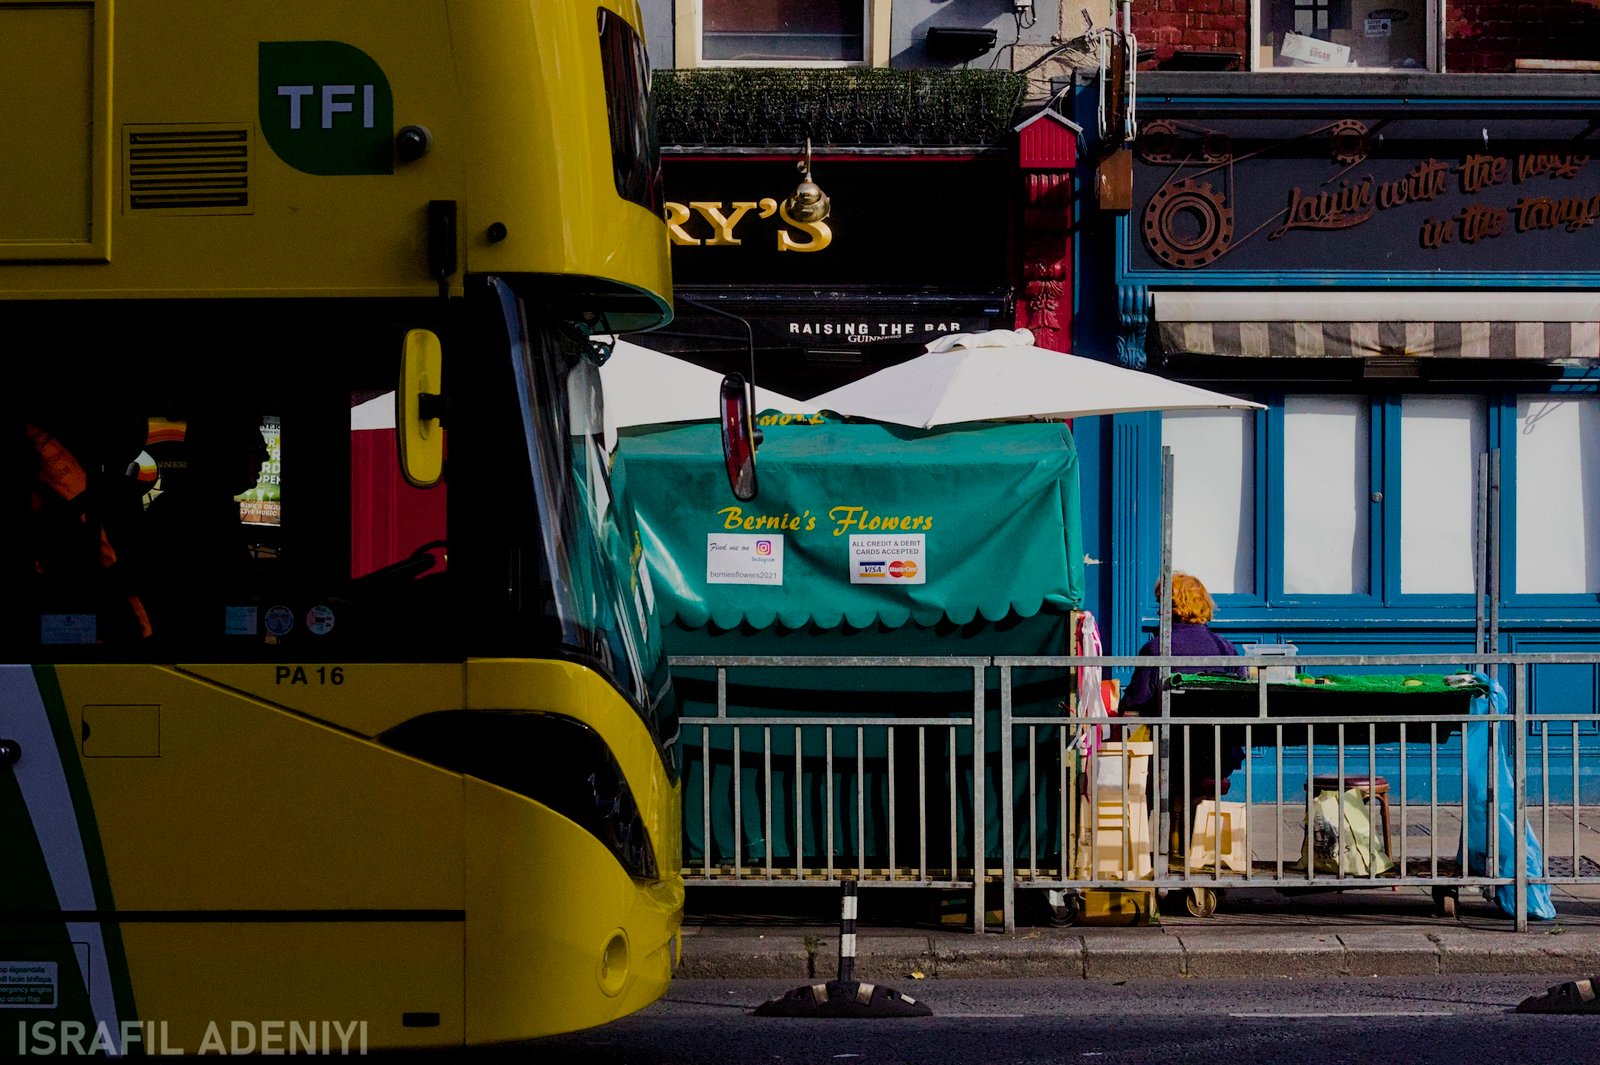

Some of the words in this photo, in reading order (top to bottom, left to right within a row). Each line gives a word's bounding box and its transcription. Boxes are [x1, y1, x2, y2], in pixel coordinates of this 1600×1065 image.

[277, 84, 374, 129] TFI
[1380, 157, 1449, 209] with
[1452, 153, 1507, 194] the
[1421, 216, 1453, 249] in
[1453, 203, 1507, 244] the
[789, 322, 869, 336] RAISING
[879, 322, 915, 336] THE
[924, 322, 961, 332] BAR
[717, 506, 817, 531] Bernie's
[828, 505, 934, 537] Flowers
[709, 542, 728, 552] Find
[710, 571, 777, 579] berniesflowers2021
[275, 666, 308, 685] PA
[316, 666, 344, 685] 16
[7, 995, 27, 1003] under
